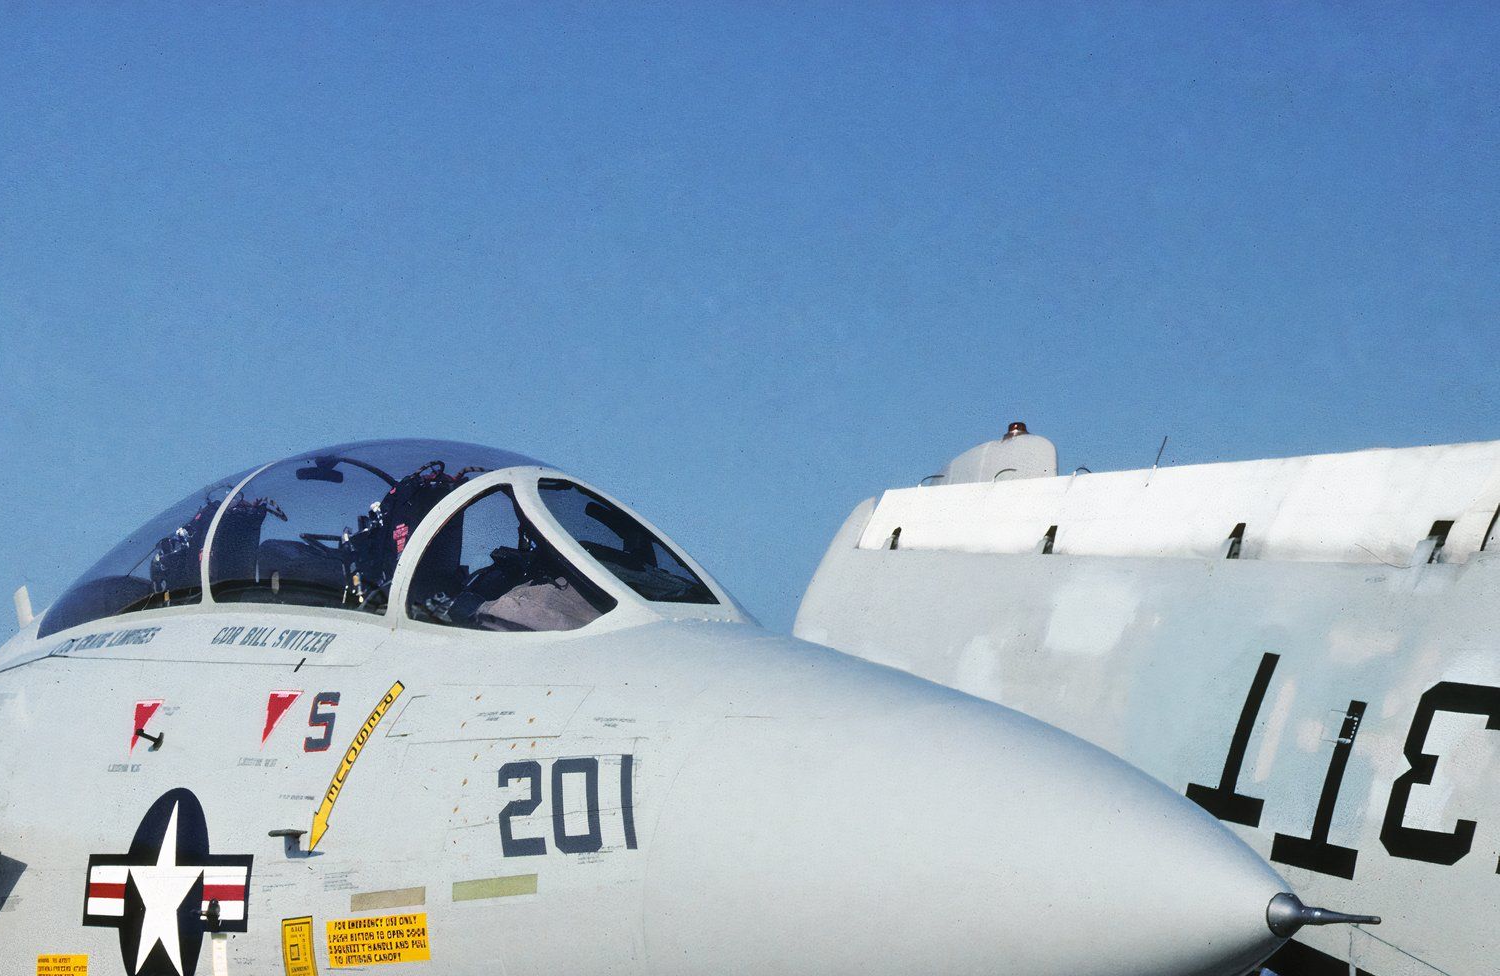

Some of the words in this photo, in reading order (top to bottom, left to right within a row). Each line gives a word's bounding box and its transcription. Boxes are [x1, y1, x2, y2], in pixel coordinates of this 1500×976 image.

[239, 627, 276, 647] BILL
[272, 629, 338, 653] SWITZER
[303, 692, 341, 752] S
[326, 693, 394, 804] RESCUE
[498, 754, 638, 858] 201
